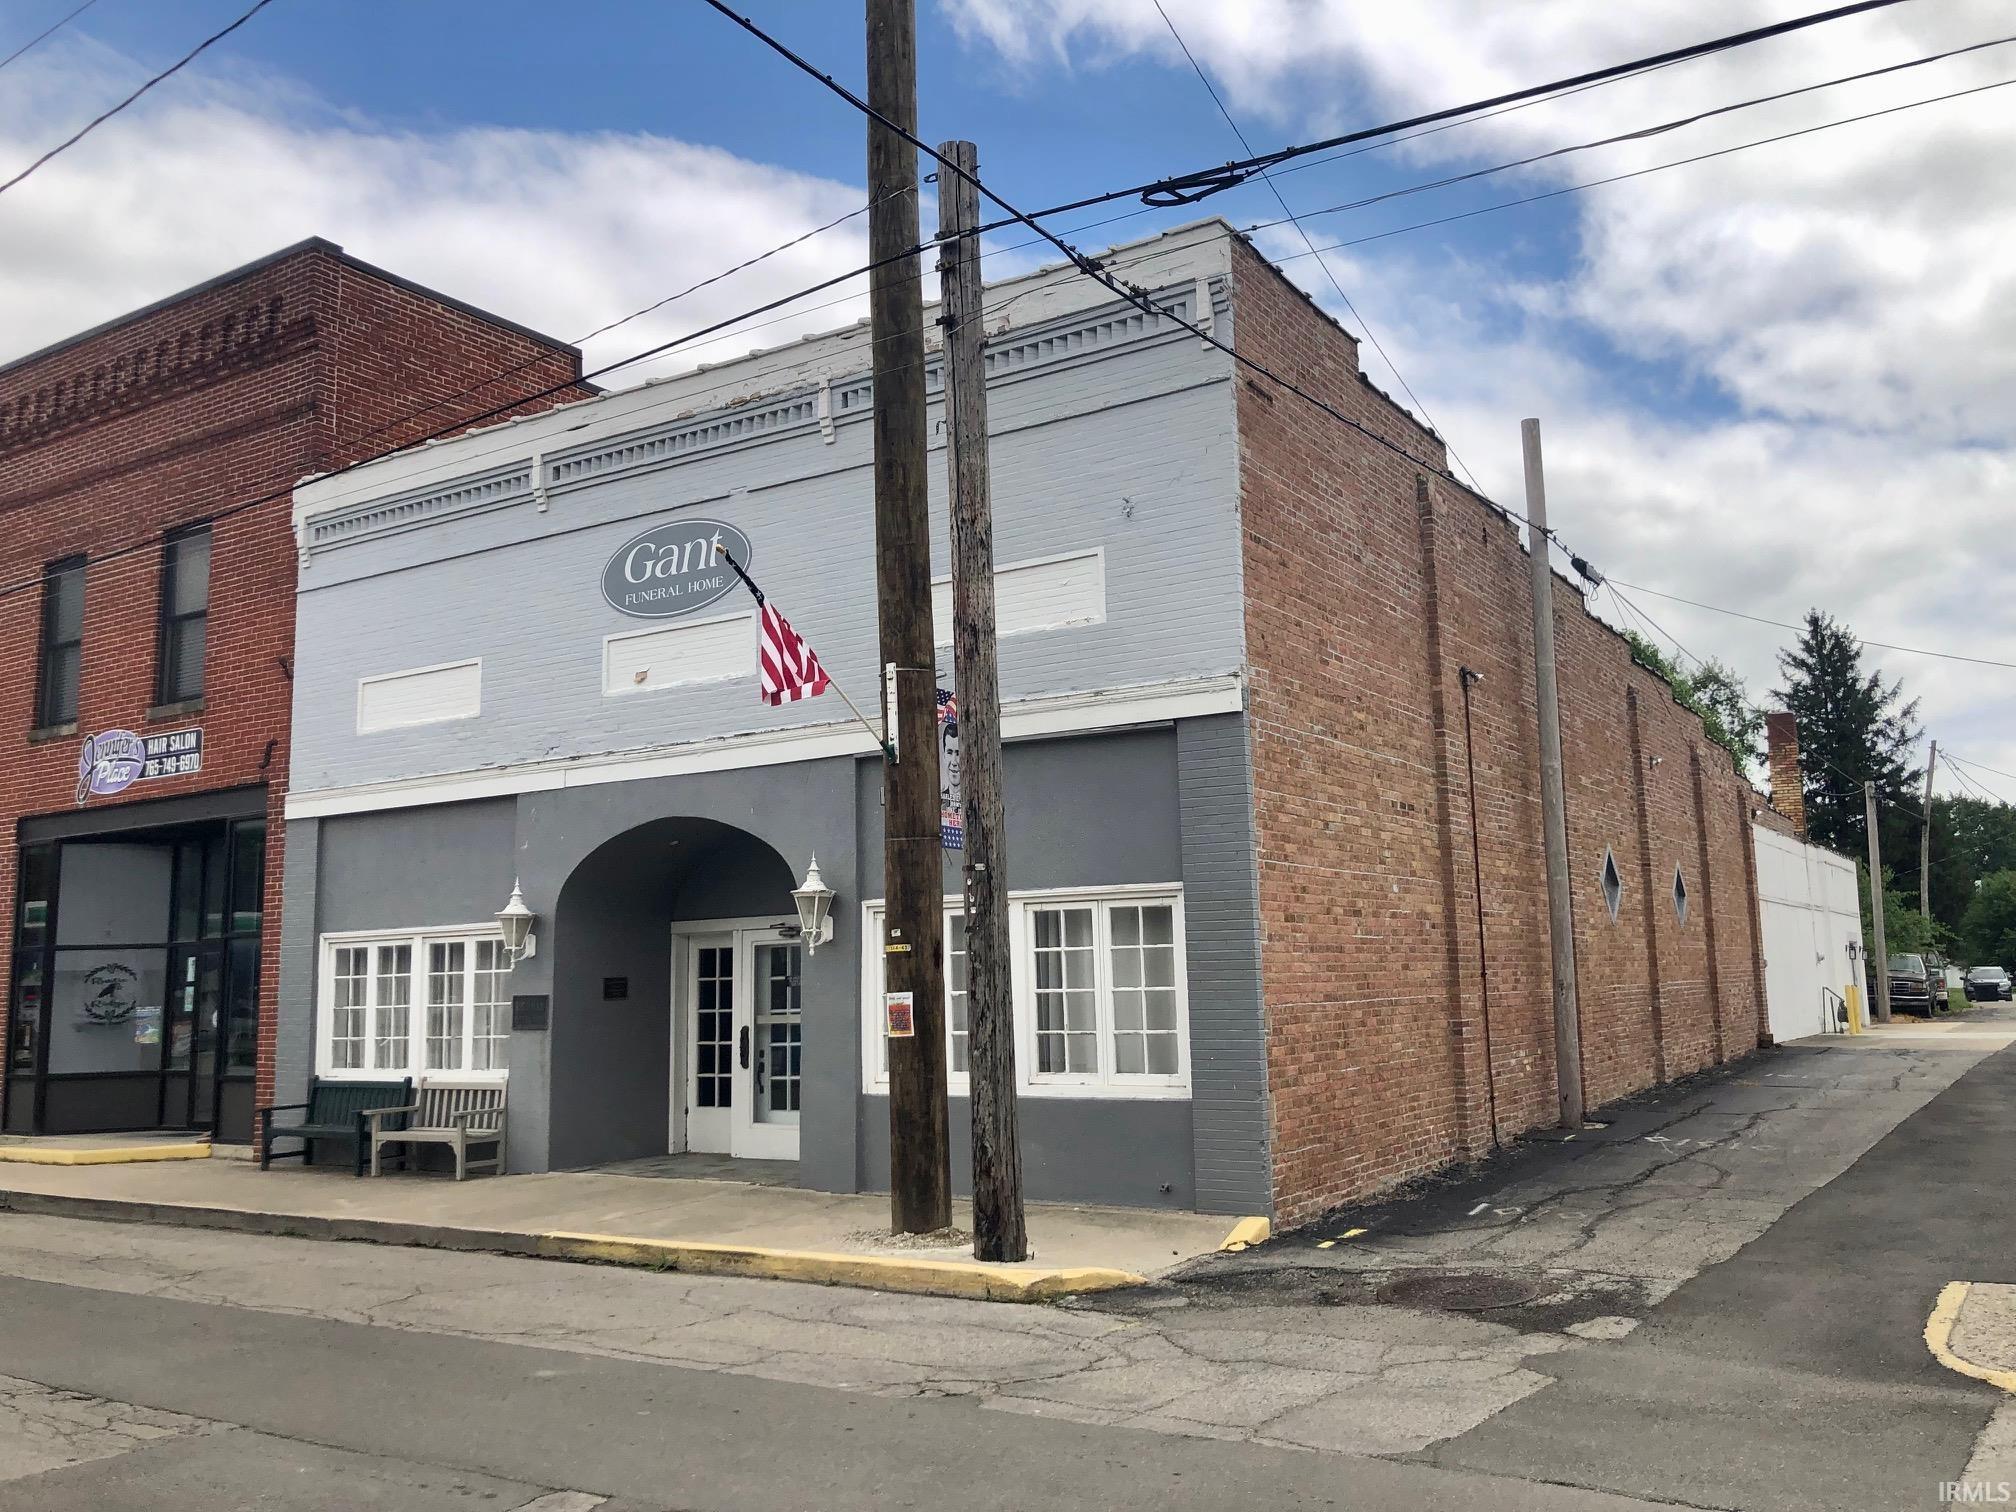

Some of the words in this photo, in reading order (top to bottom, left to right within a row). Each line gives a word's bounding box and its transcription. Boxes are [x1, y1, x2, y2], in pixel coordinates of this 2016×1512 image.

[625, 528, 723, 584] Gant
[625, 585, 683, 606] FUNERAL
[688, 576, 724, 593] HOME
[148, 737, 168, 755] HAIR
[169, 732, 197, 752] SALON
[95, 760, 131, 787] Place
[145, 753, 200, 777] 765-749-6970
